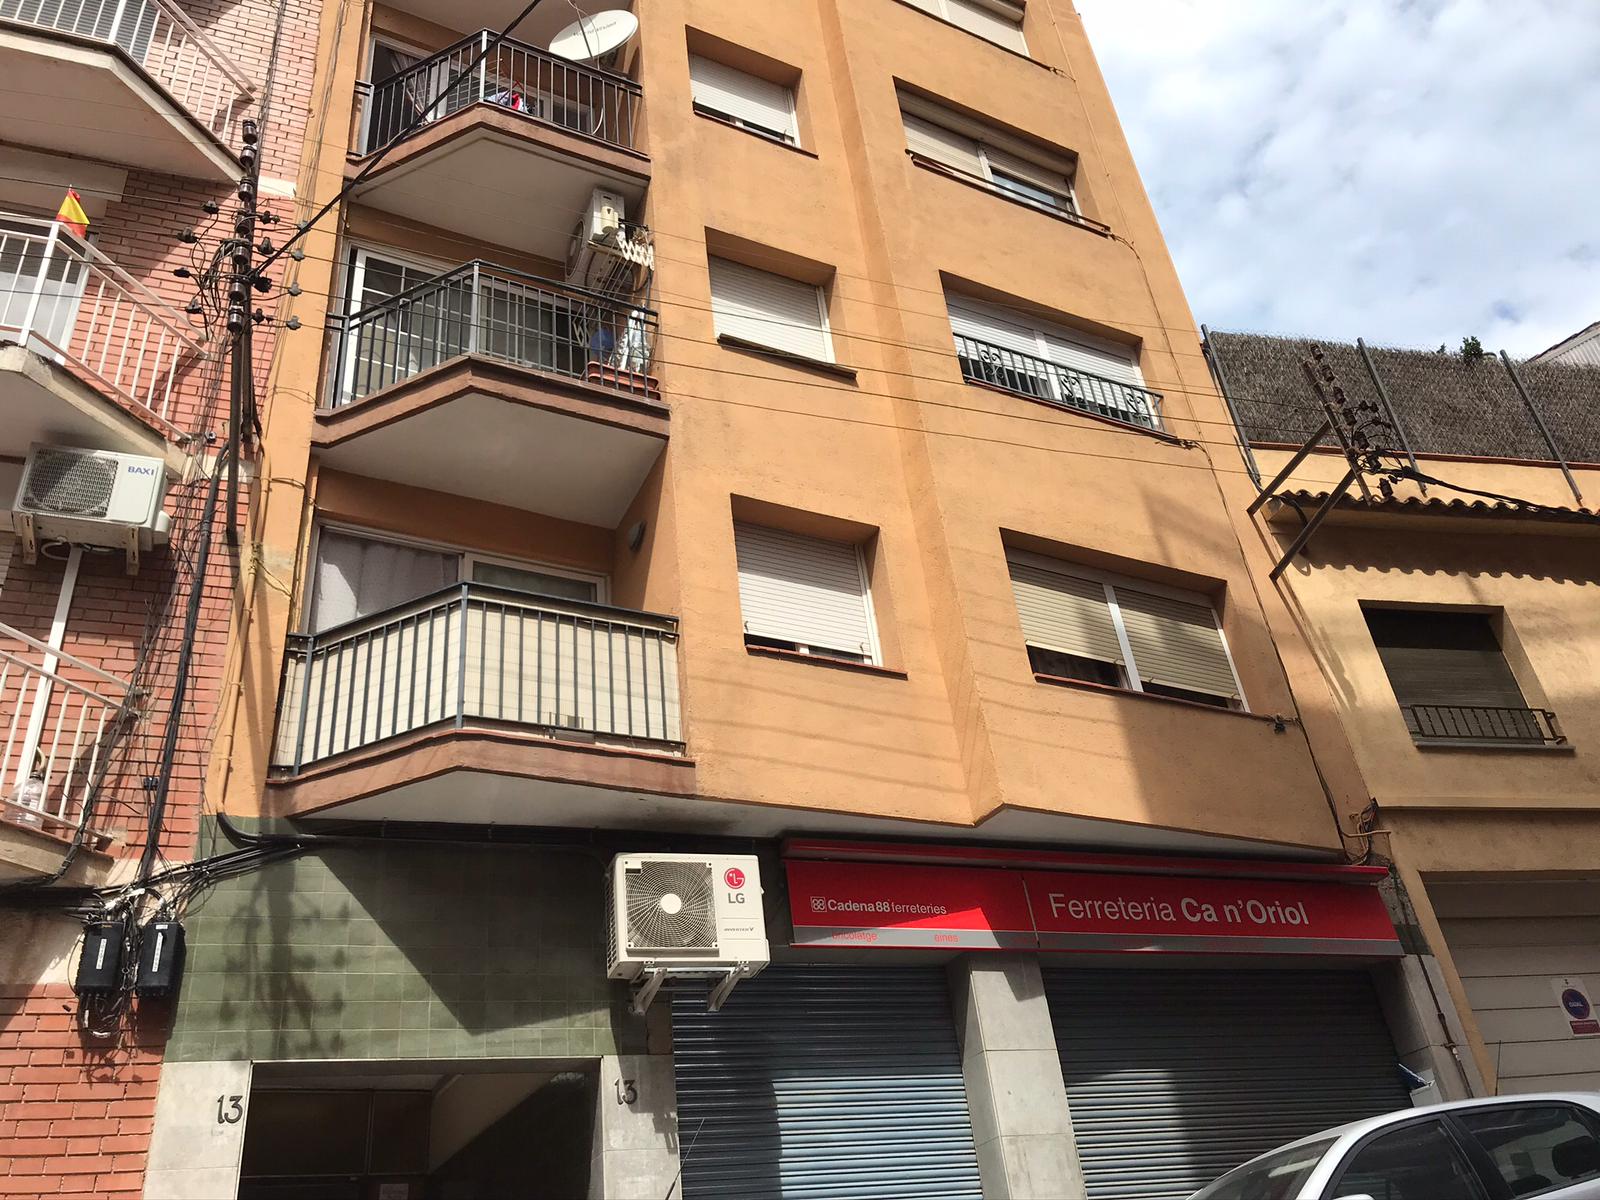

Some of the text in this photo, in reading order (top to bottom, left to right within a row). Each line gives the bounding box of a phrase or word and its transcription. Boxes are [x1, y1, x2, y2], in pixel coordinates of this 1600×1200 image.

[128, 466, 154, 475] BAXI
[728, 892, 745, 904] LG
[828, 899, 890, 912] Cadena88
[891, 901, 947, 914] ferreteries
[1048, 892, 1310, 925] Ferreteria Ca n'Oriol
[614, 1078, 638, 1105] 13
[217, 1094, 244, 1124] 13
